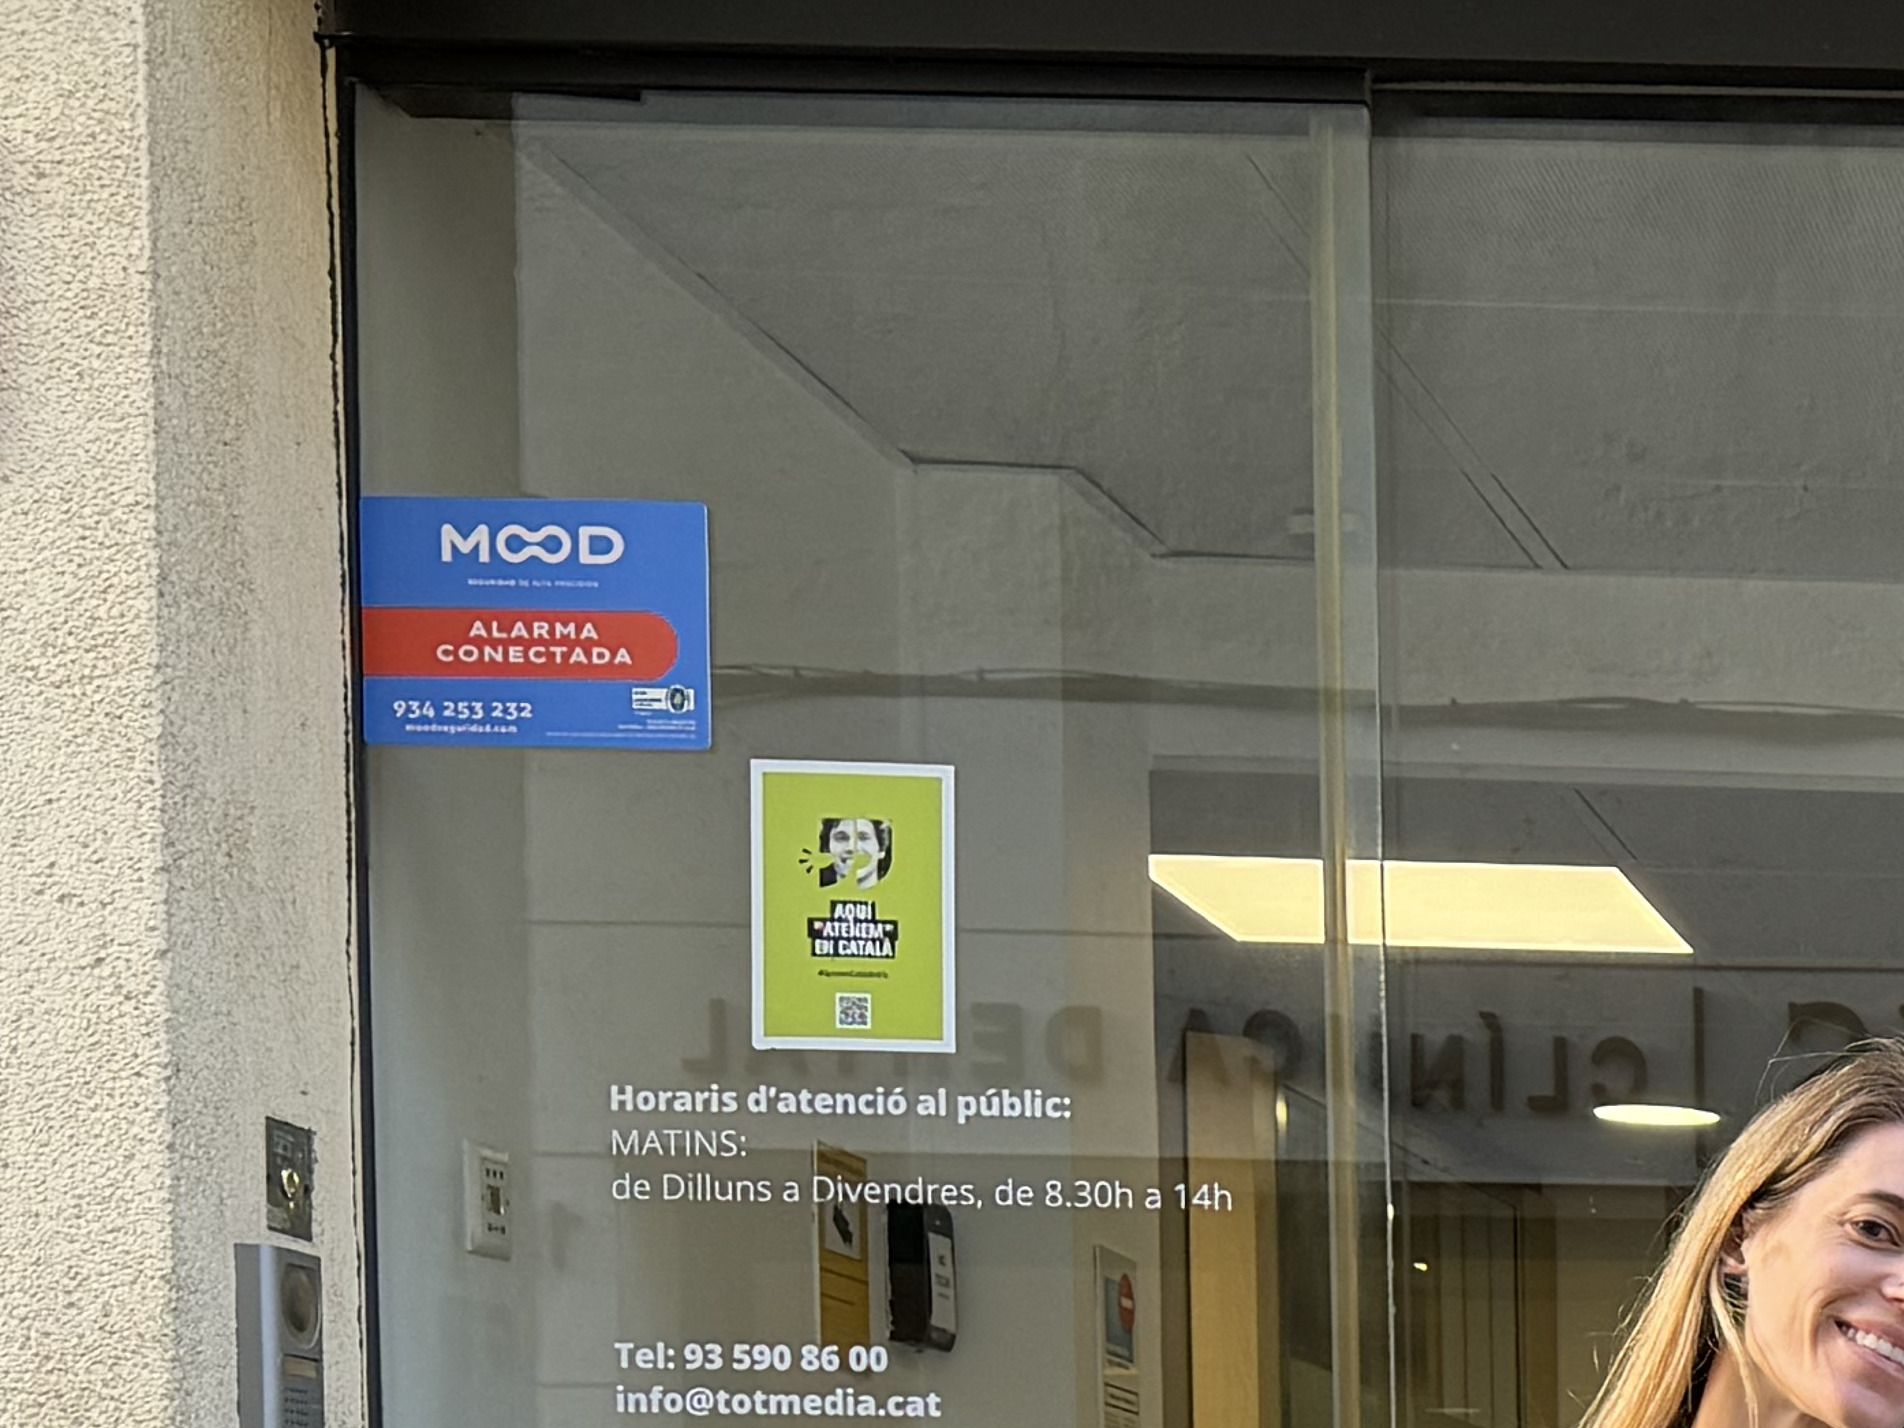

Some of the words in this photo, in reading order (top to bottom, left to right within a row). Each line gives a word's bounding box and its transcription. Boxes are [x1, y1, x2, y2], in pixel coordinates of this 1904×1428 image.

[440, 523, 625, 565] MOOD
[468, 620, 599, 640] ALARMA
[436, 644, 633, 665] CONECTADA
[392, 700, 435, 719] 934
[442, 701, 484, 720] 253
[491, 701, 533, 720] 232
[609, 1085, 739, 1115] Horaris
[746, 1085, 908, 1117] d'atenció
[916, 1087, 948, 1117] al
[956, 1087, 1073, 1124] públic:
[611, 1130, 747, 1157] MATINS:
[612, 1174, 651, 1201] de
[661, 1174, 772, 1202] Dilluns
[782, 1182, 800, 1202] a
[812, 1176, 983, 1210] Divendres,
[994, 1179, 1034, 1206] de
[1044, 1181, 1134, 1209] 8.30h
[1144, 1188, 1162, 1209] a
[1173, 1183, 1233, 1212] 14h
[614, 1343, 676, 1370] Tel:
[684, 1343, 723, 1371] 93
[732, 1344, 791, 1372] 590
[800, 1345, 840, 1372] 86
[848, 1346, 888, 1373] 00
[615, 1386, 942, 1418] info@totmedia.cat
